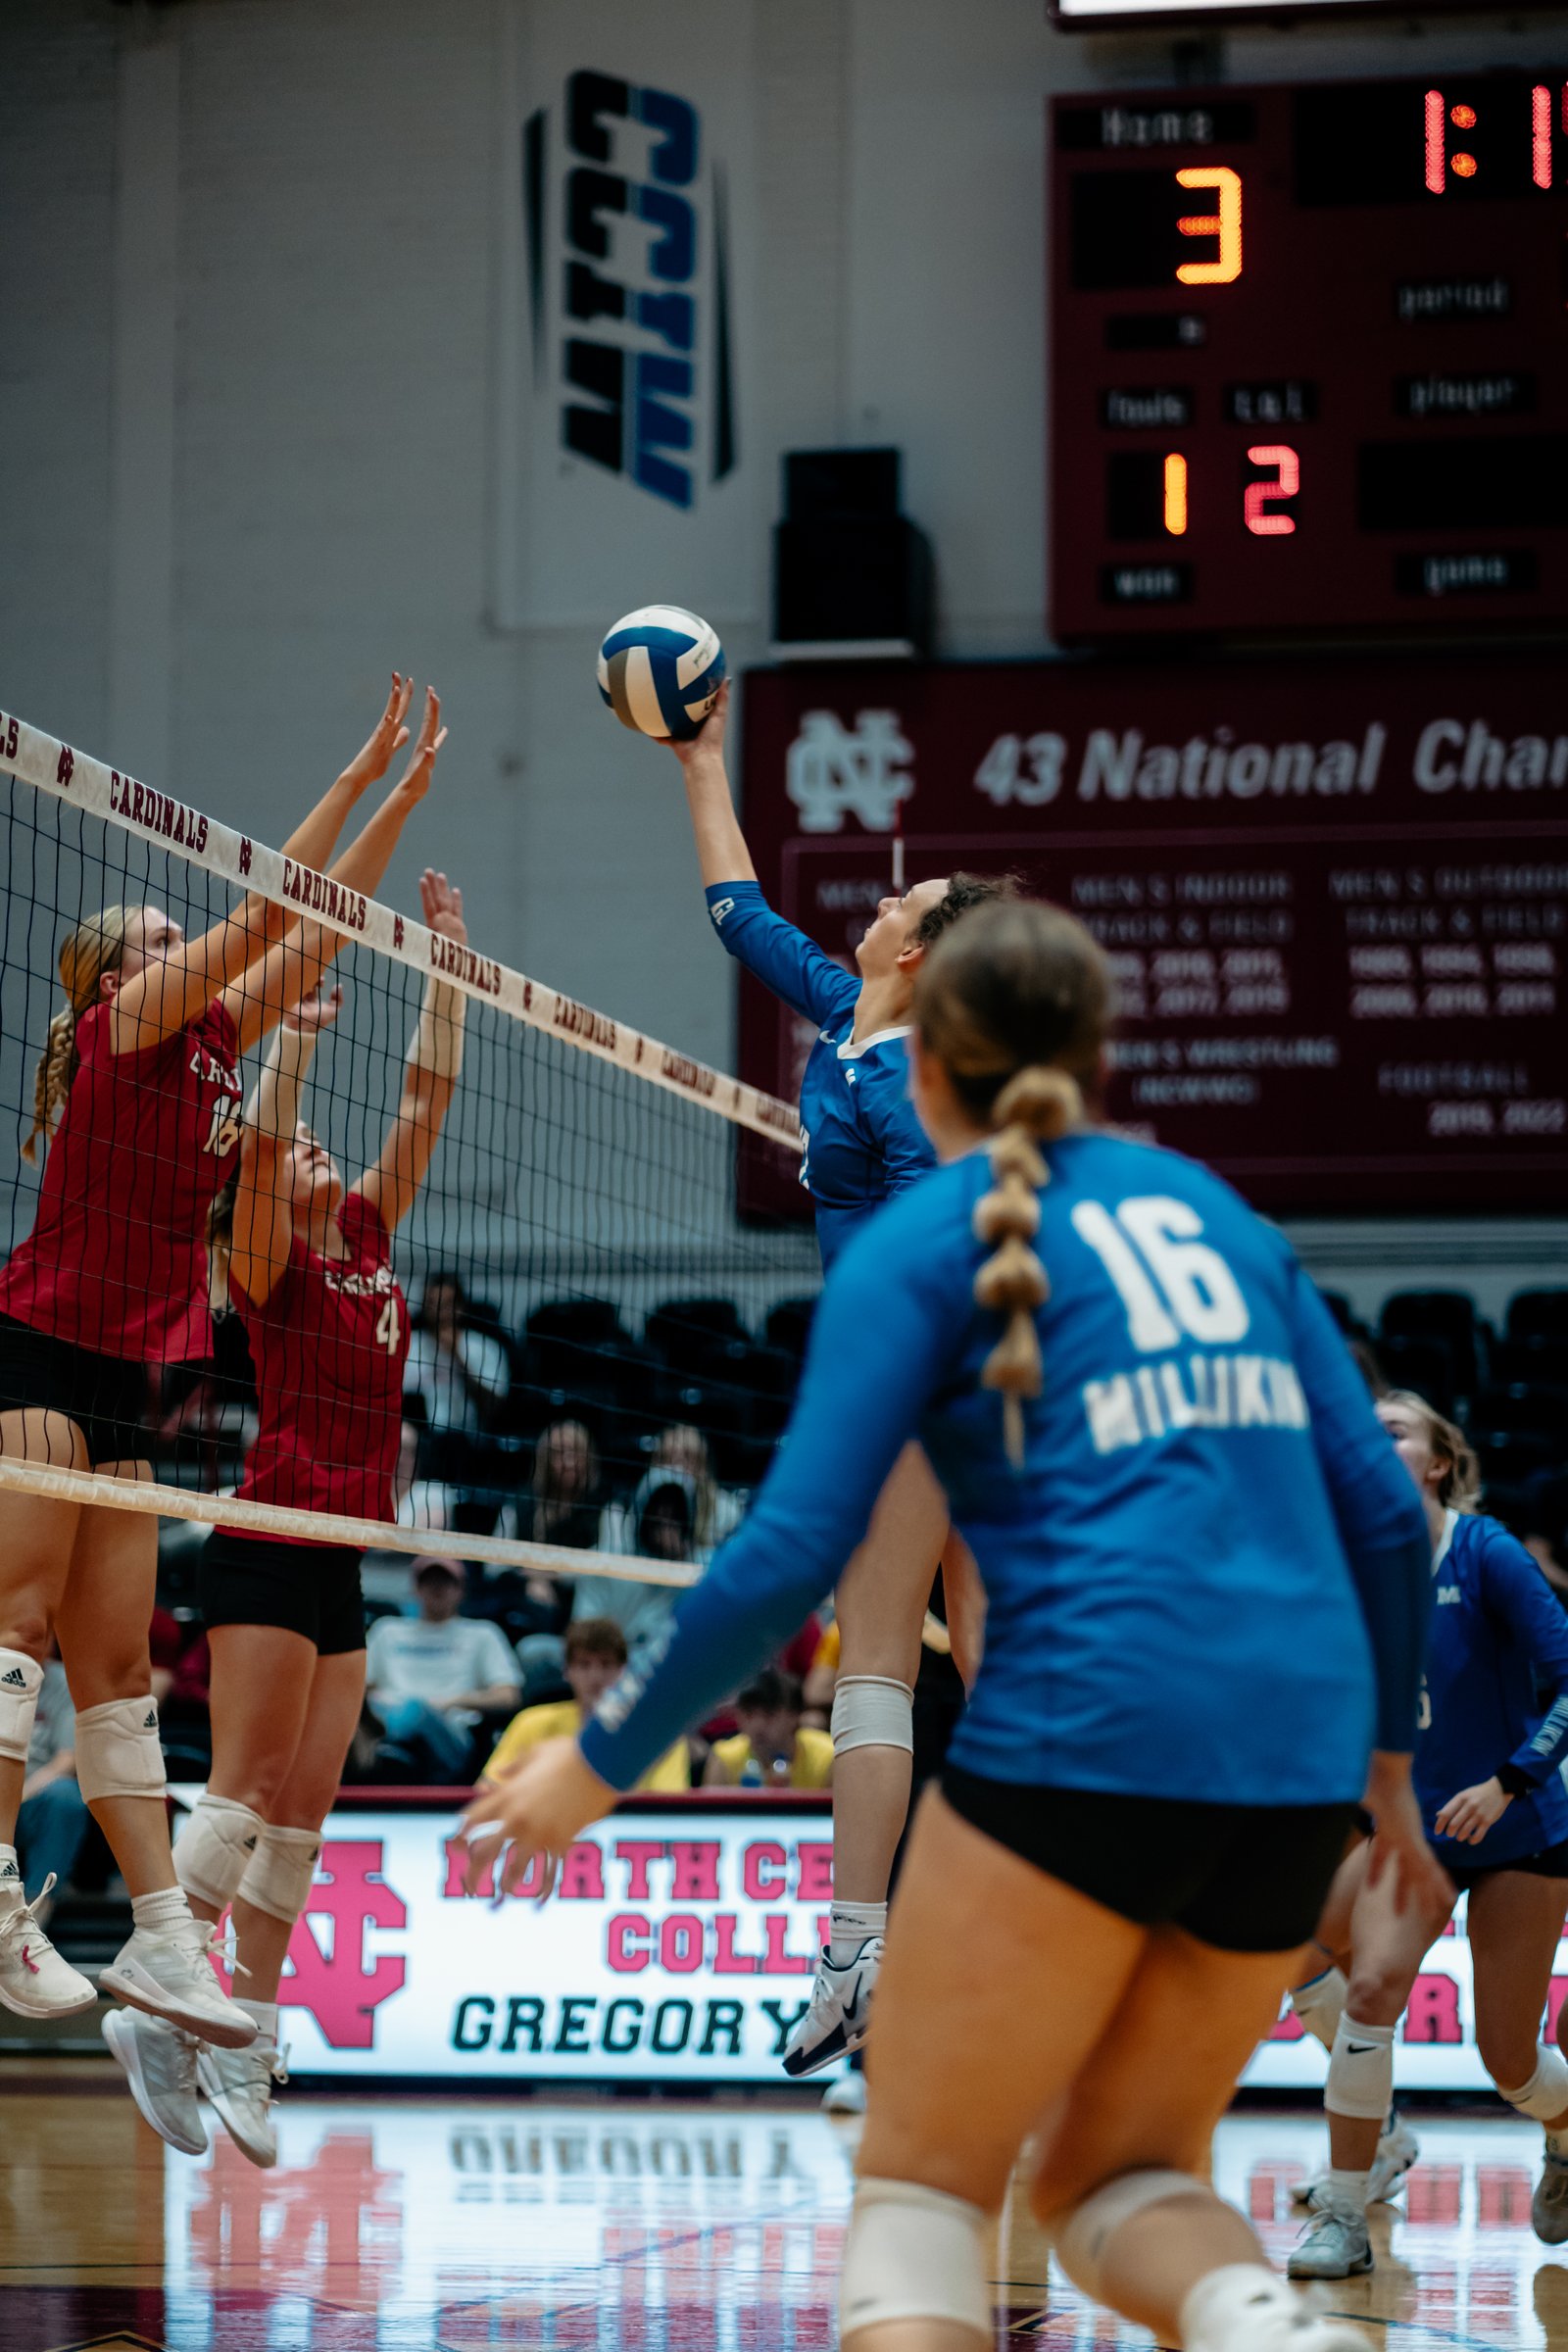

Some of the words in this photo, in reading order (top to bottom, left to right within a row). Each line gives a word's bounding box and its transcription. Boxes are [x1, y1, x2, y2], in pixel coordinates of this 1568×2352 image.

[1425, 84, 1568, 194] 1:1
[1176, 167, 1242, 284] 3
[564, 68, 699, 513] CCIW
[1164, 453, 1187, 535] 1
[1244, 445, 1299, 535] 2
[974, 730, 1068, 808] 43
[1078, 721, 1385, 802] National
[110, 769, 209, 854] CARDINALS
[282, 858, 367, 932] CARDINALS
[430, 932, 502, 997] CARDINALS
[1070, 1194, 1250, 1354] 16
[376, 1298, 401, 1356] 4
[743, 1839, 835, 1901] CE
[452, 1995, 810, 2055] GREGORY
